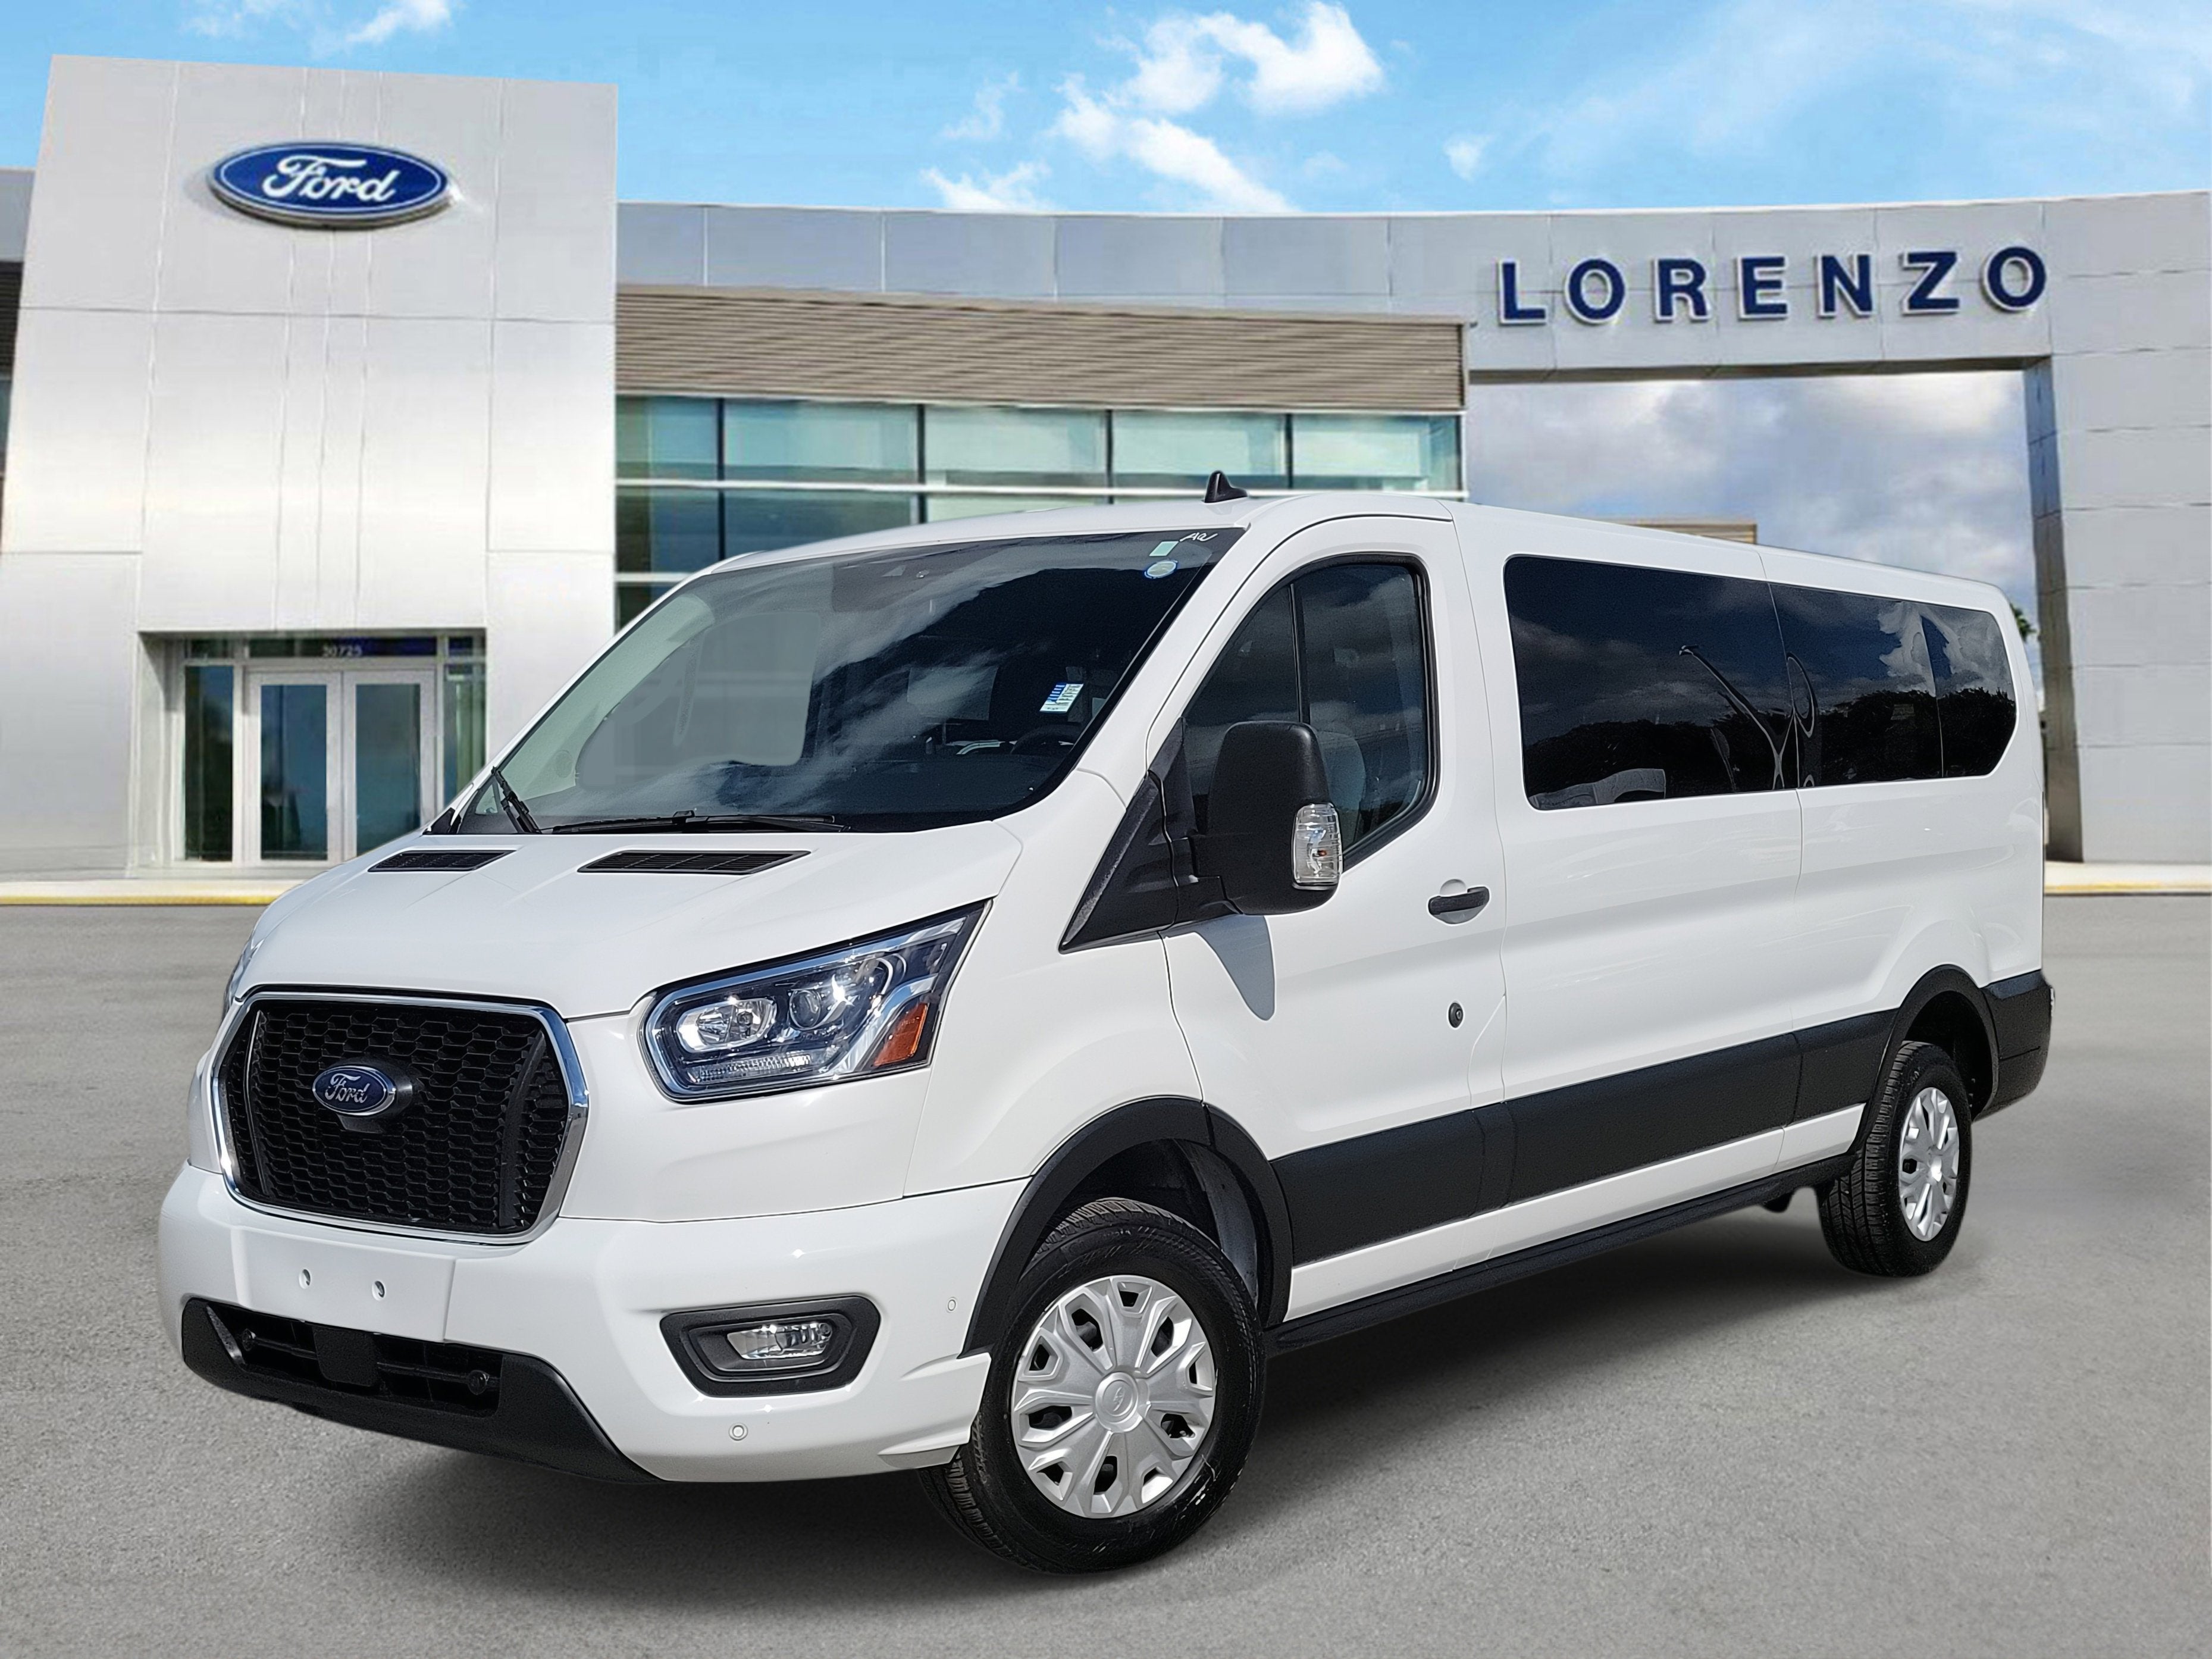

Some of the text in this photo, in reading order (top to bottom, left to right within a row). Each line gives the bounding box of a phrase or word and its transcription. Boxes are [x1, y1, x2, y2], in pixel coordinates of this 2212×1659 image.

[262, 154, 400, 202] Ford
[1499, 246, 2047, 324] LORENZO
[325, 1073, 370, 1103] Ford
